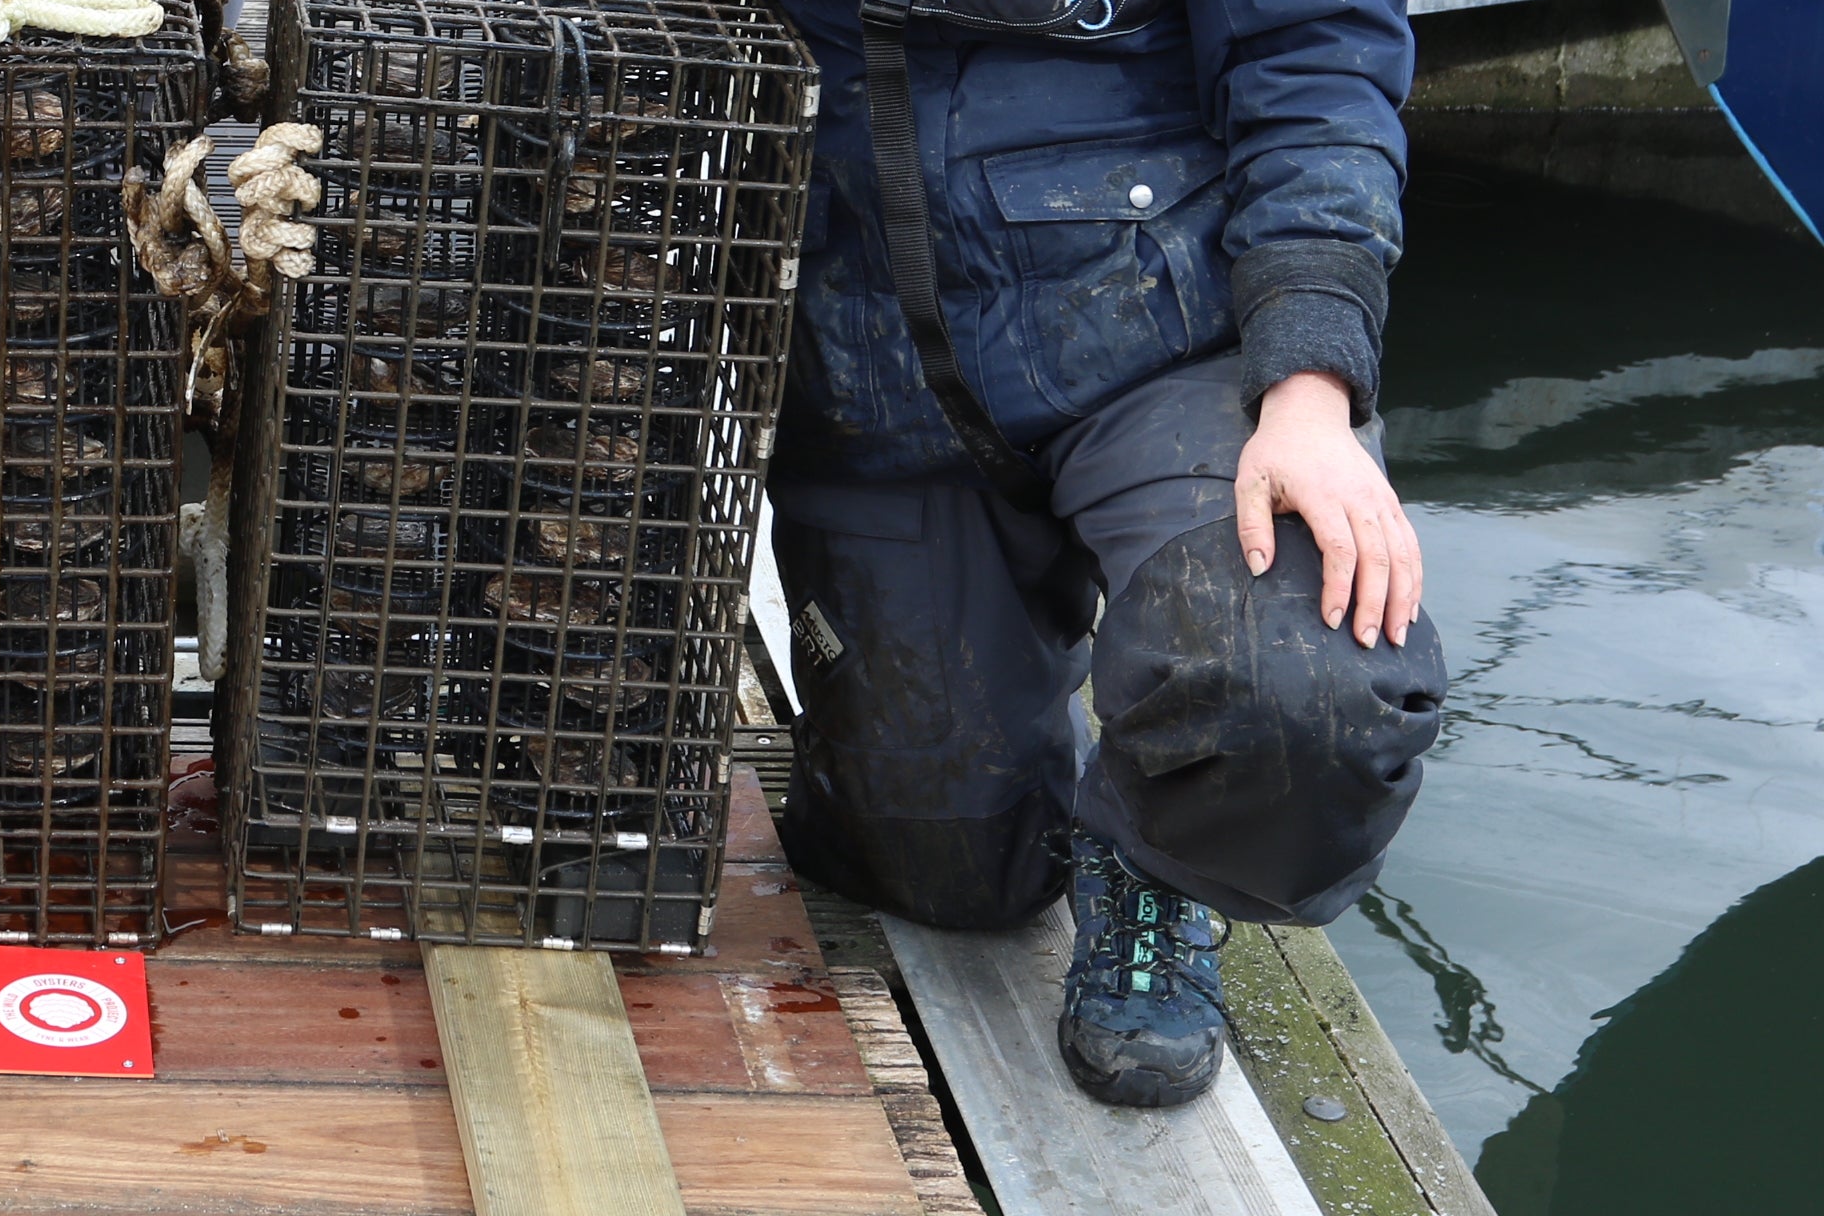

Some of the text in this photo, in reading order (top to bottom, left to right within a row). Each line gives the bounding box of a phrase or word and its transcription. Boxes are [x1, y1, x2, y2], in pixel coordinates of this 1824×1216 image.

[801, 610, 837, 661] MUSTO
[33, 977, 86, 989] OYSTERS
[101, 997, 120, 1024] PROJECT
